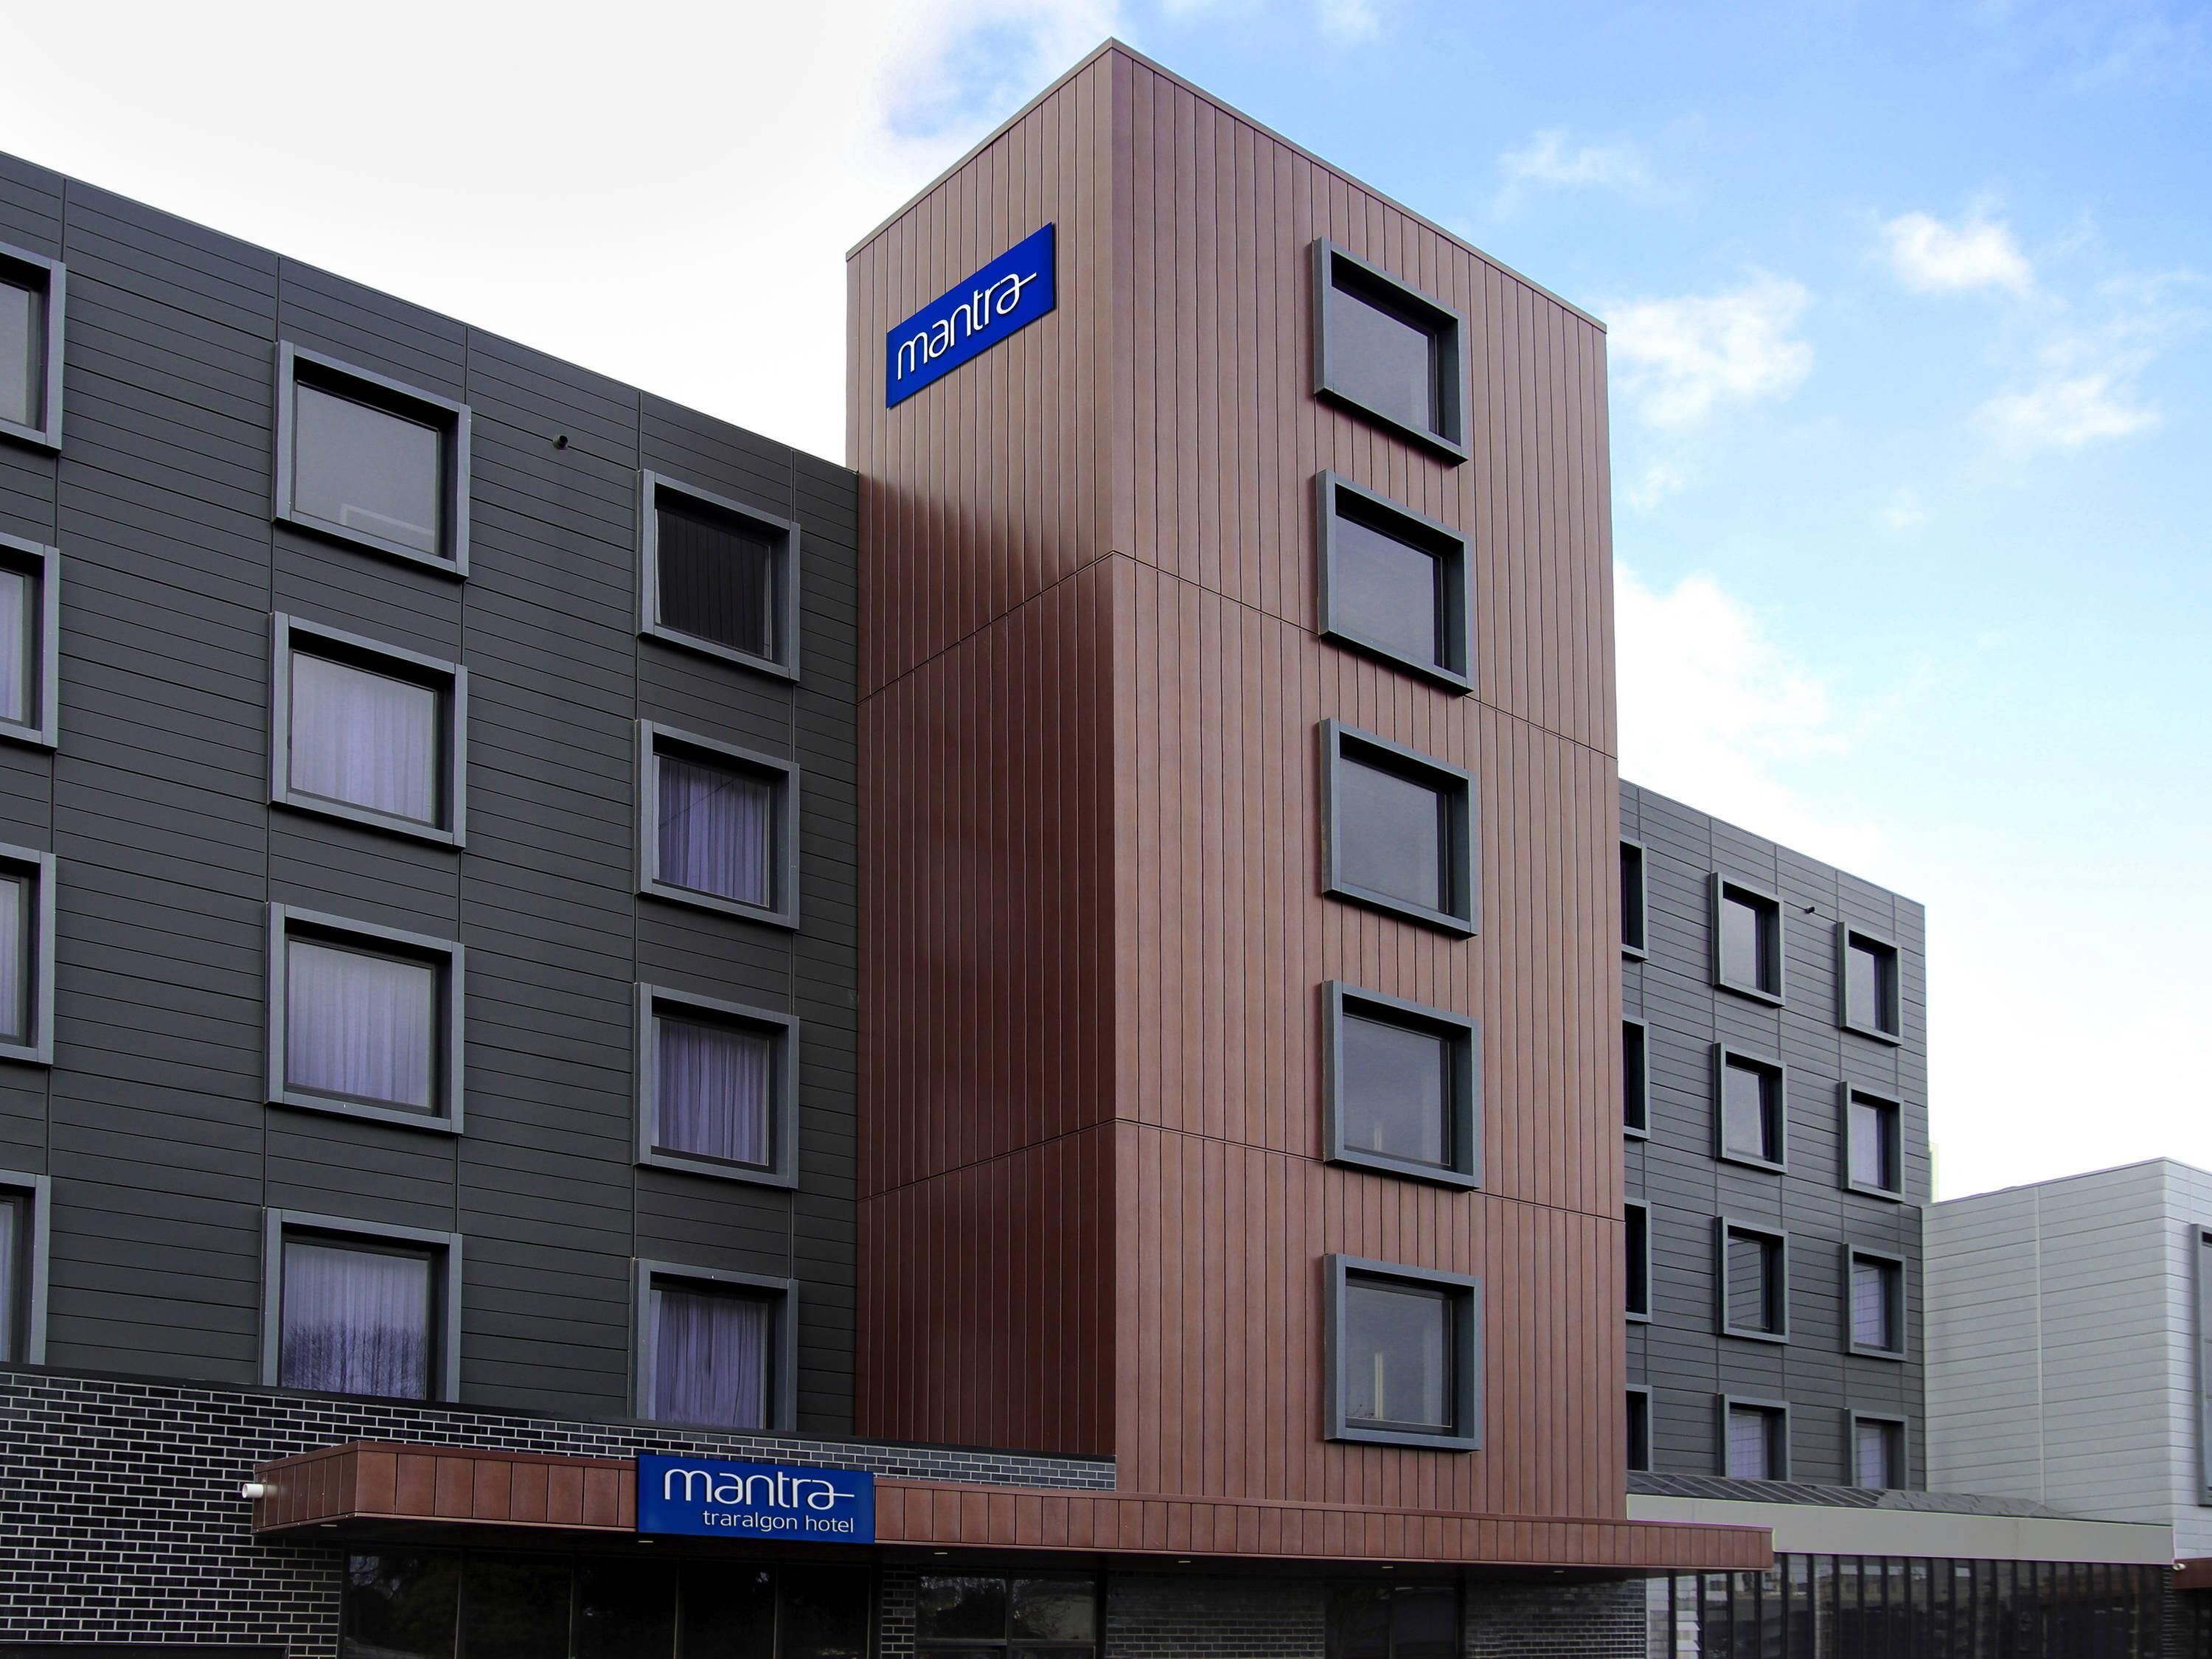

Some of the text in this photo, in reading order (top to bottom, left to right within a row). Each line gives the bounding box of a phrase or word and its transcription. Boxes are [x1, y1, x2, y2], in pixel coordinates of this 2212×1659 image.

[897, 272, 1037, 380] mantra
[664, 1469, 855, 1510] mantra
[703, 1510, 854, 1533] traralgon hotel
